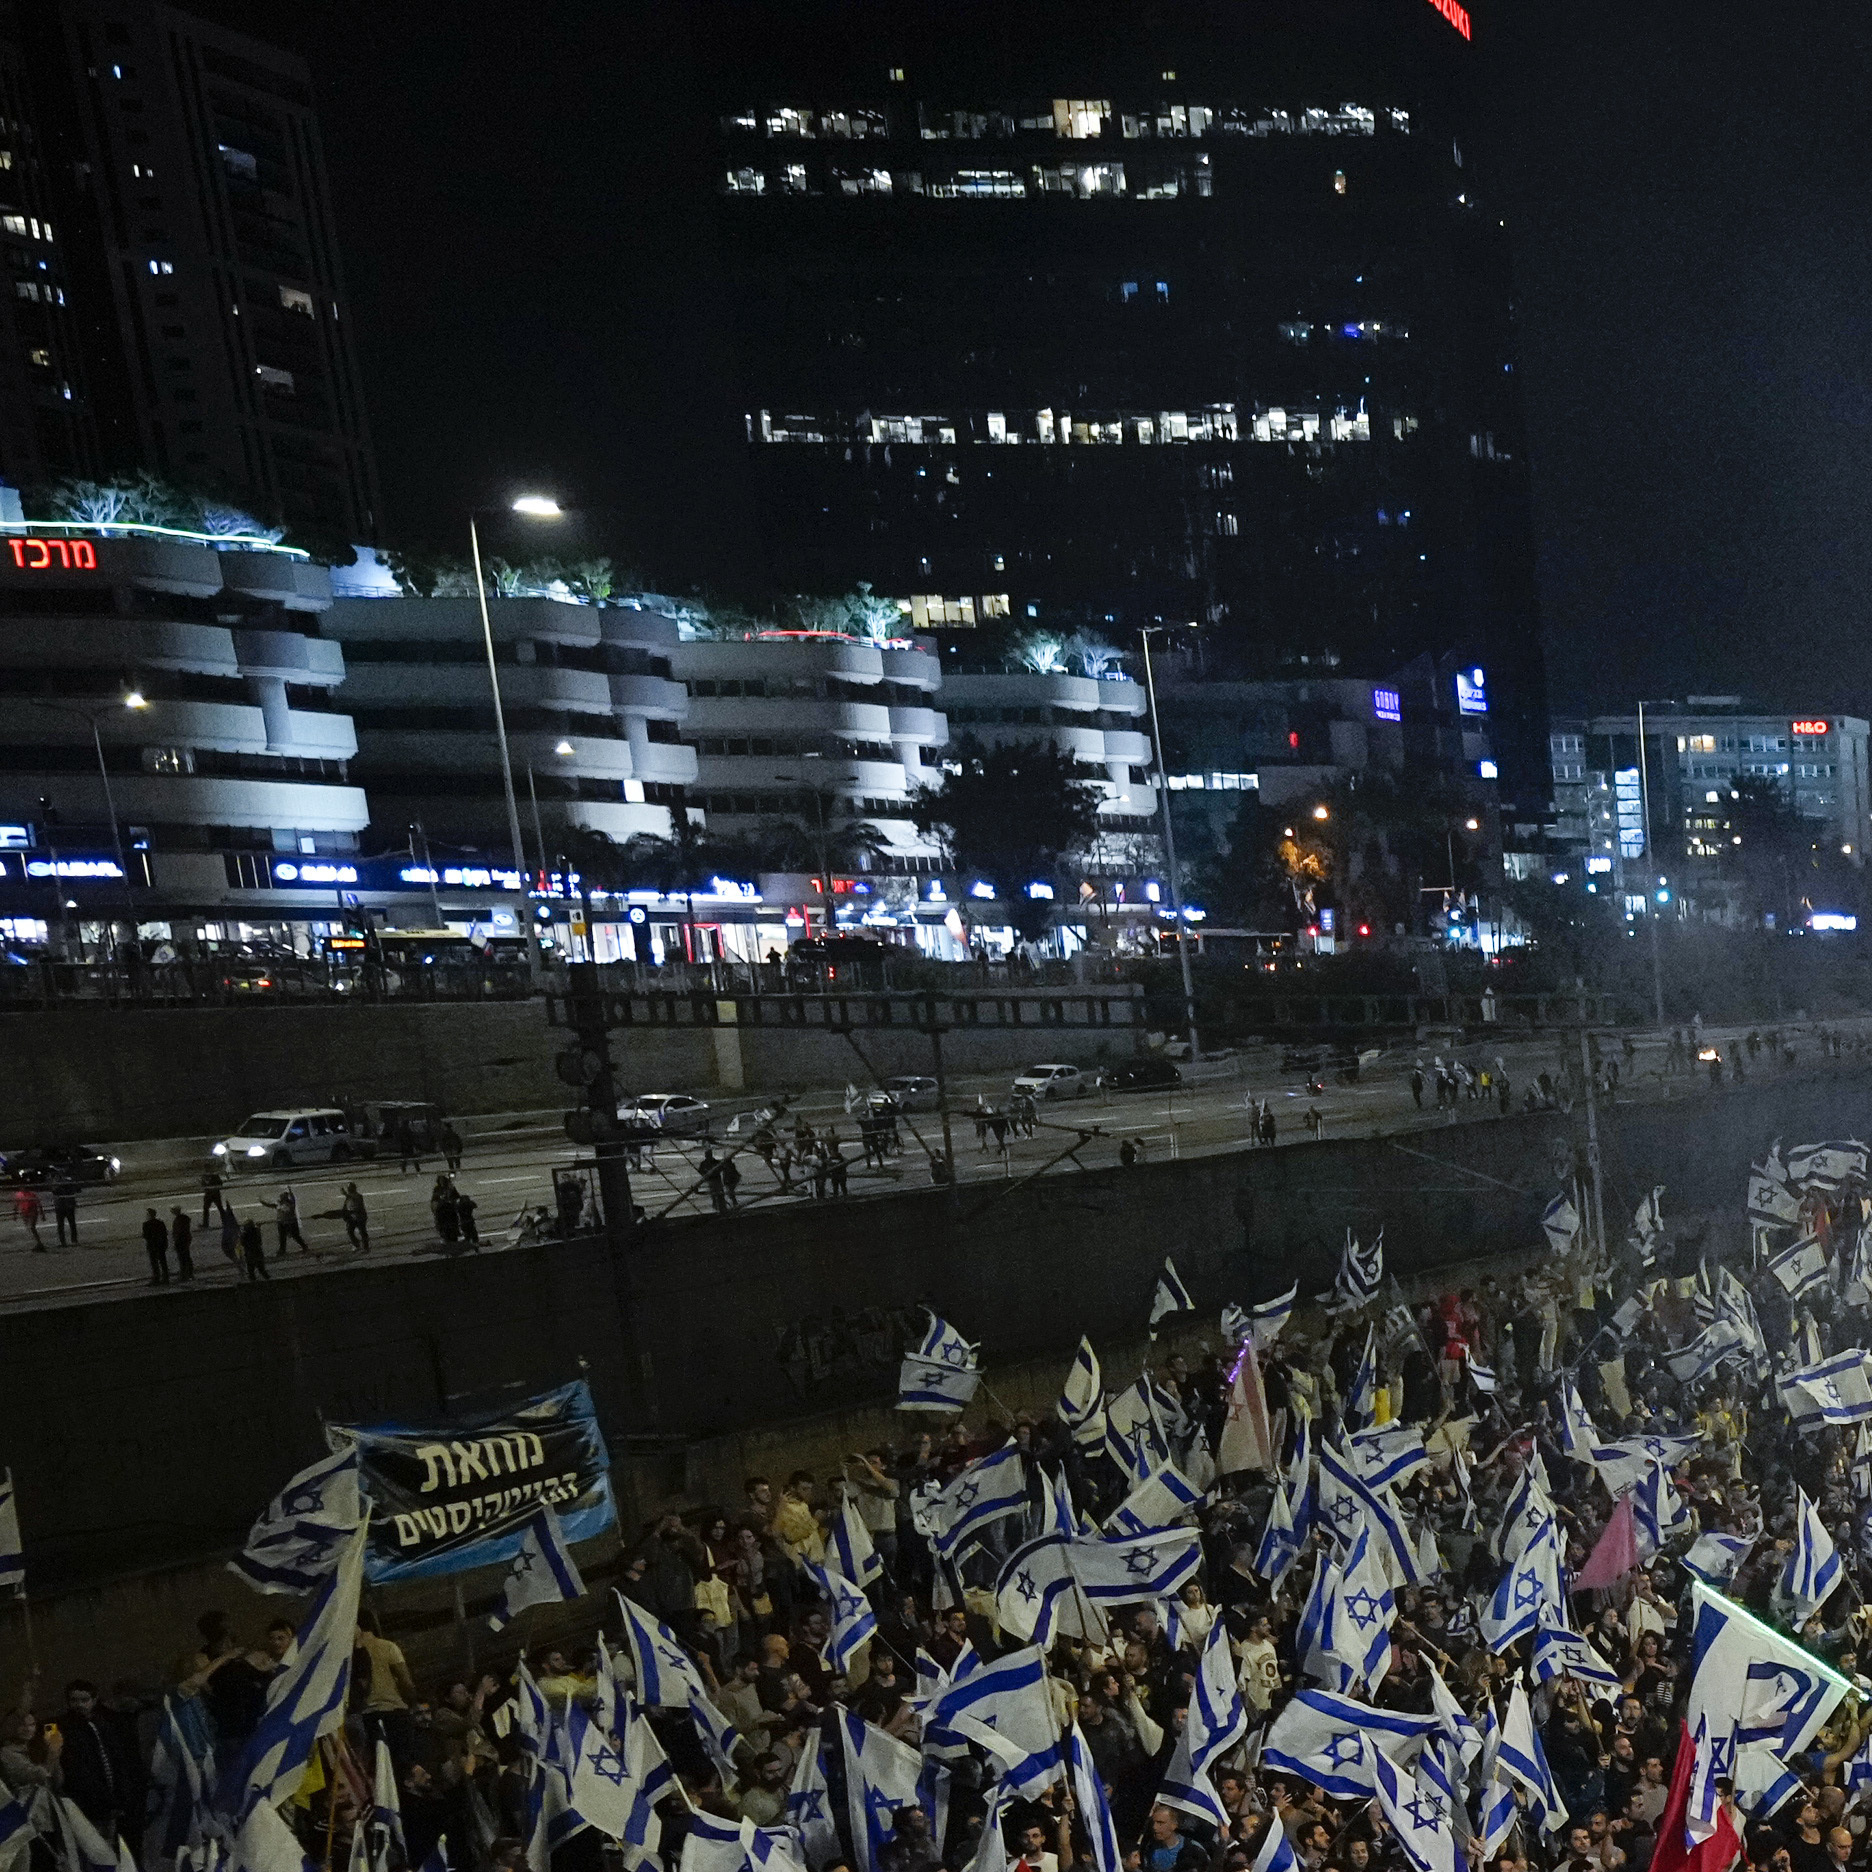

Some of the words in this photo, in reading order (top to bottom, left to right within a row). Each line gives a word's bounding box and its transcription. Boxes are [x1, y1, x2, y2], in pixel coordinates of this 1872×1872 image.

[1429, 0, 1471, 41] UZUKI
[8, 539, 97, 569] מרכז
[1792, 721, 1828, 734] H&O
[415, 1432, 545, 1493] מחאת
